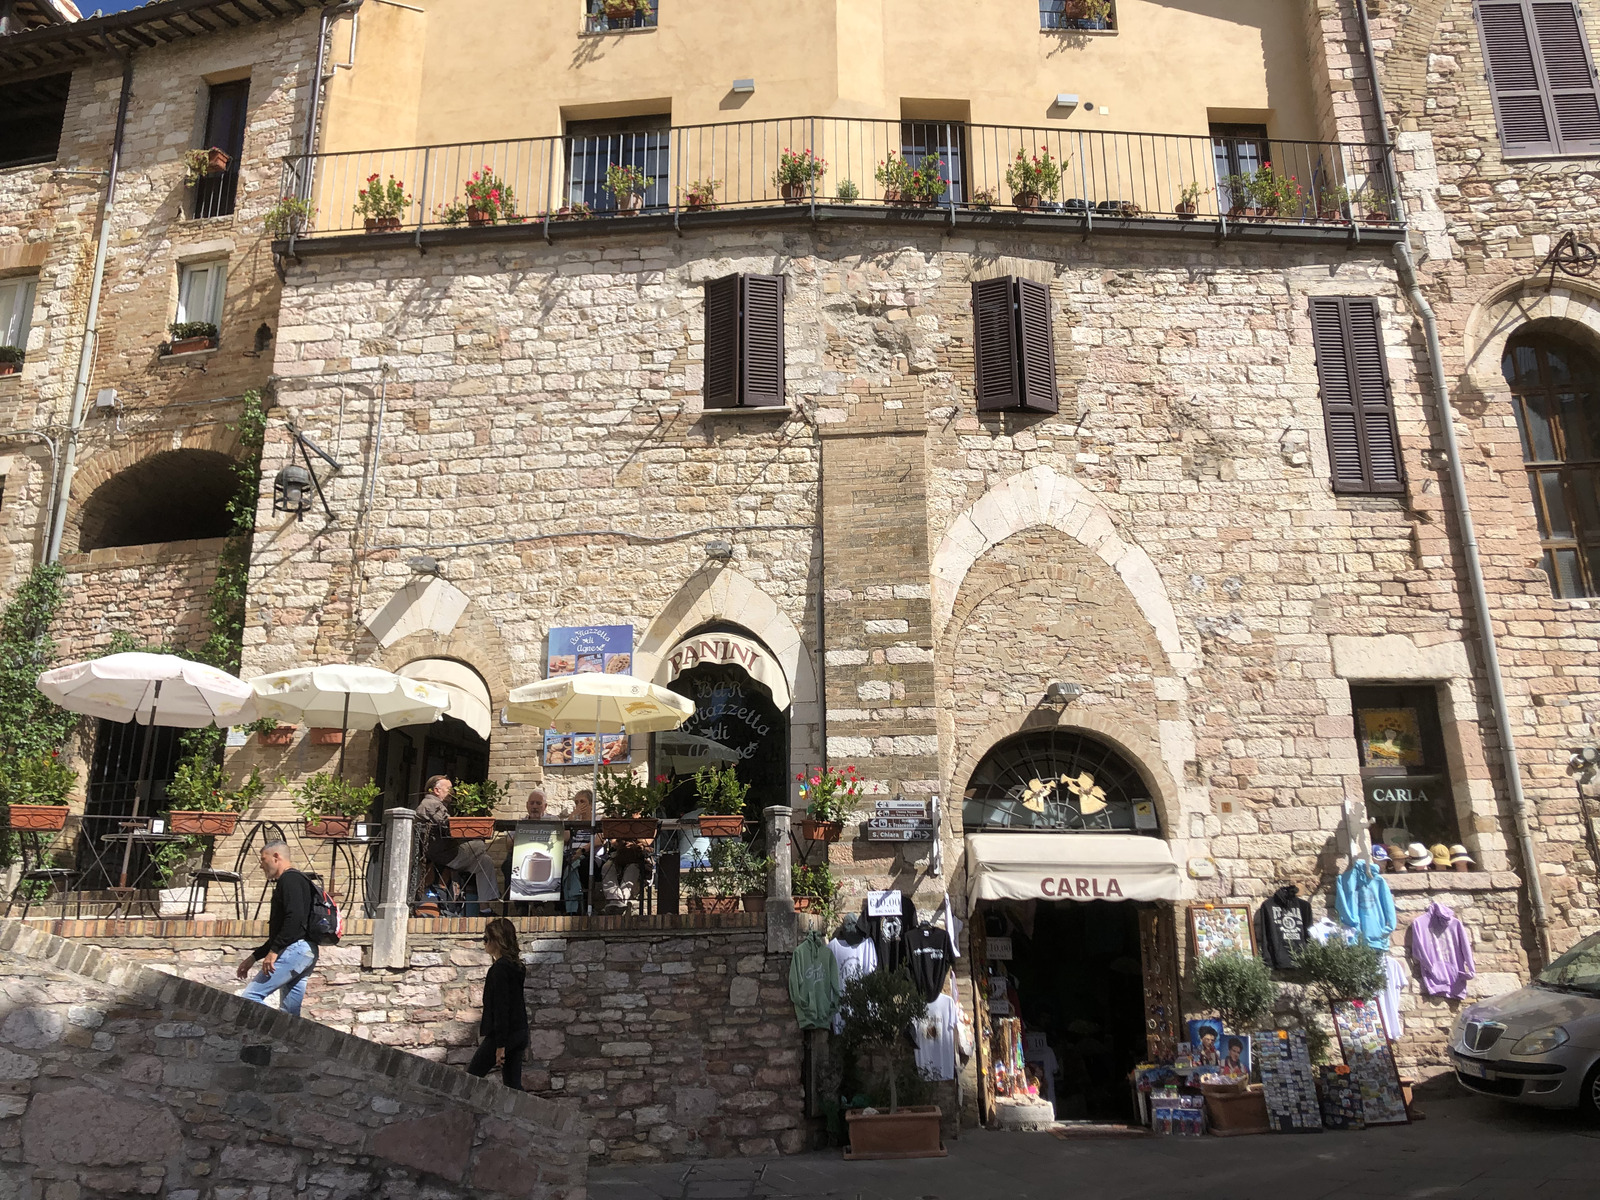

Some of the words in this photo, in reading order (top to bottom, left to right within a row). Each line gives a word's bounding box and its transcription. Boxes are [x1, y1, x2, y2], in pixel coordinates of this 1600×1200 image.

[668, 641, 760, 675] PANINI
[696, 681, 745, 698] BAR
[712, 722, 730, 739] di
[1373, 788, 1429, 802] CARLA
[1040, 877, 1124, 897] CARLA
